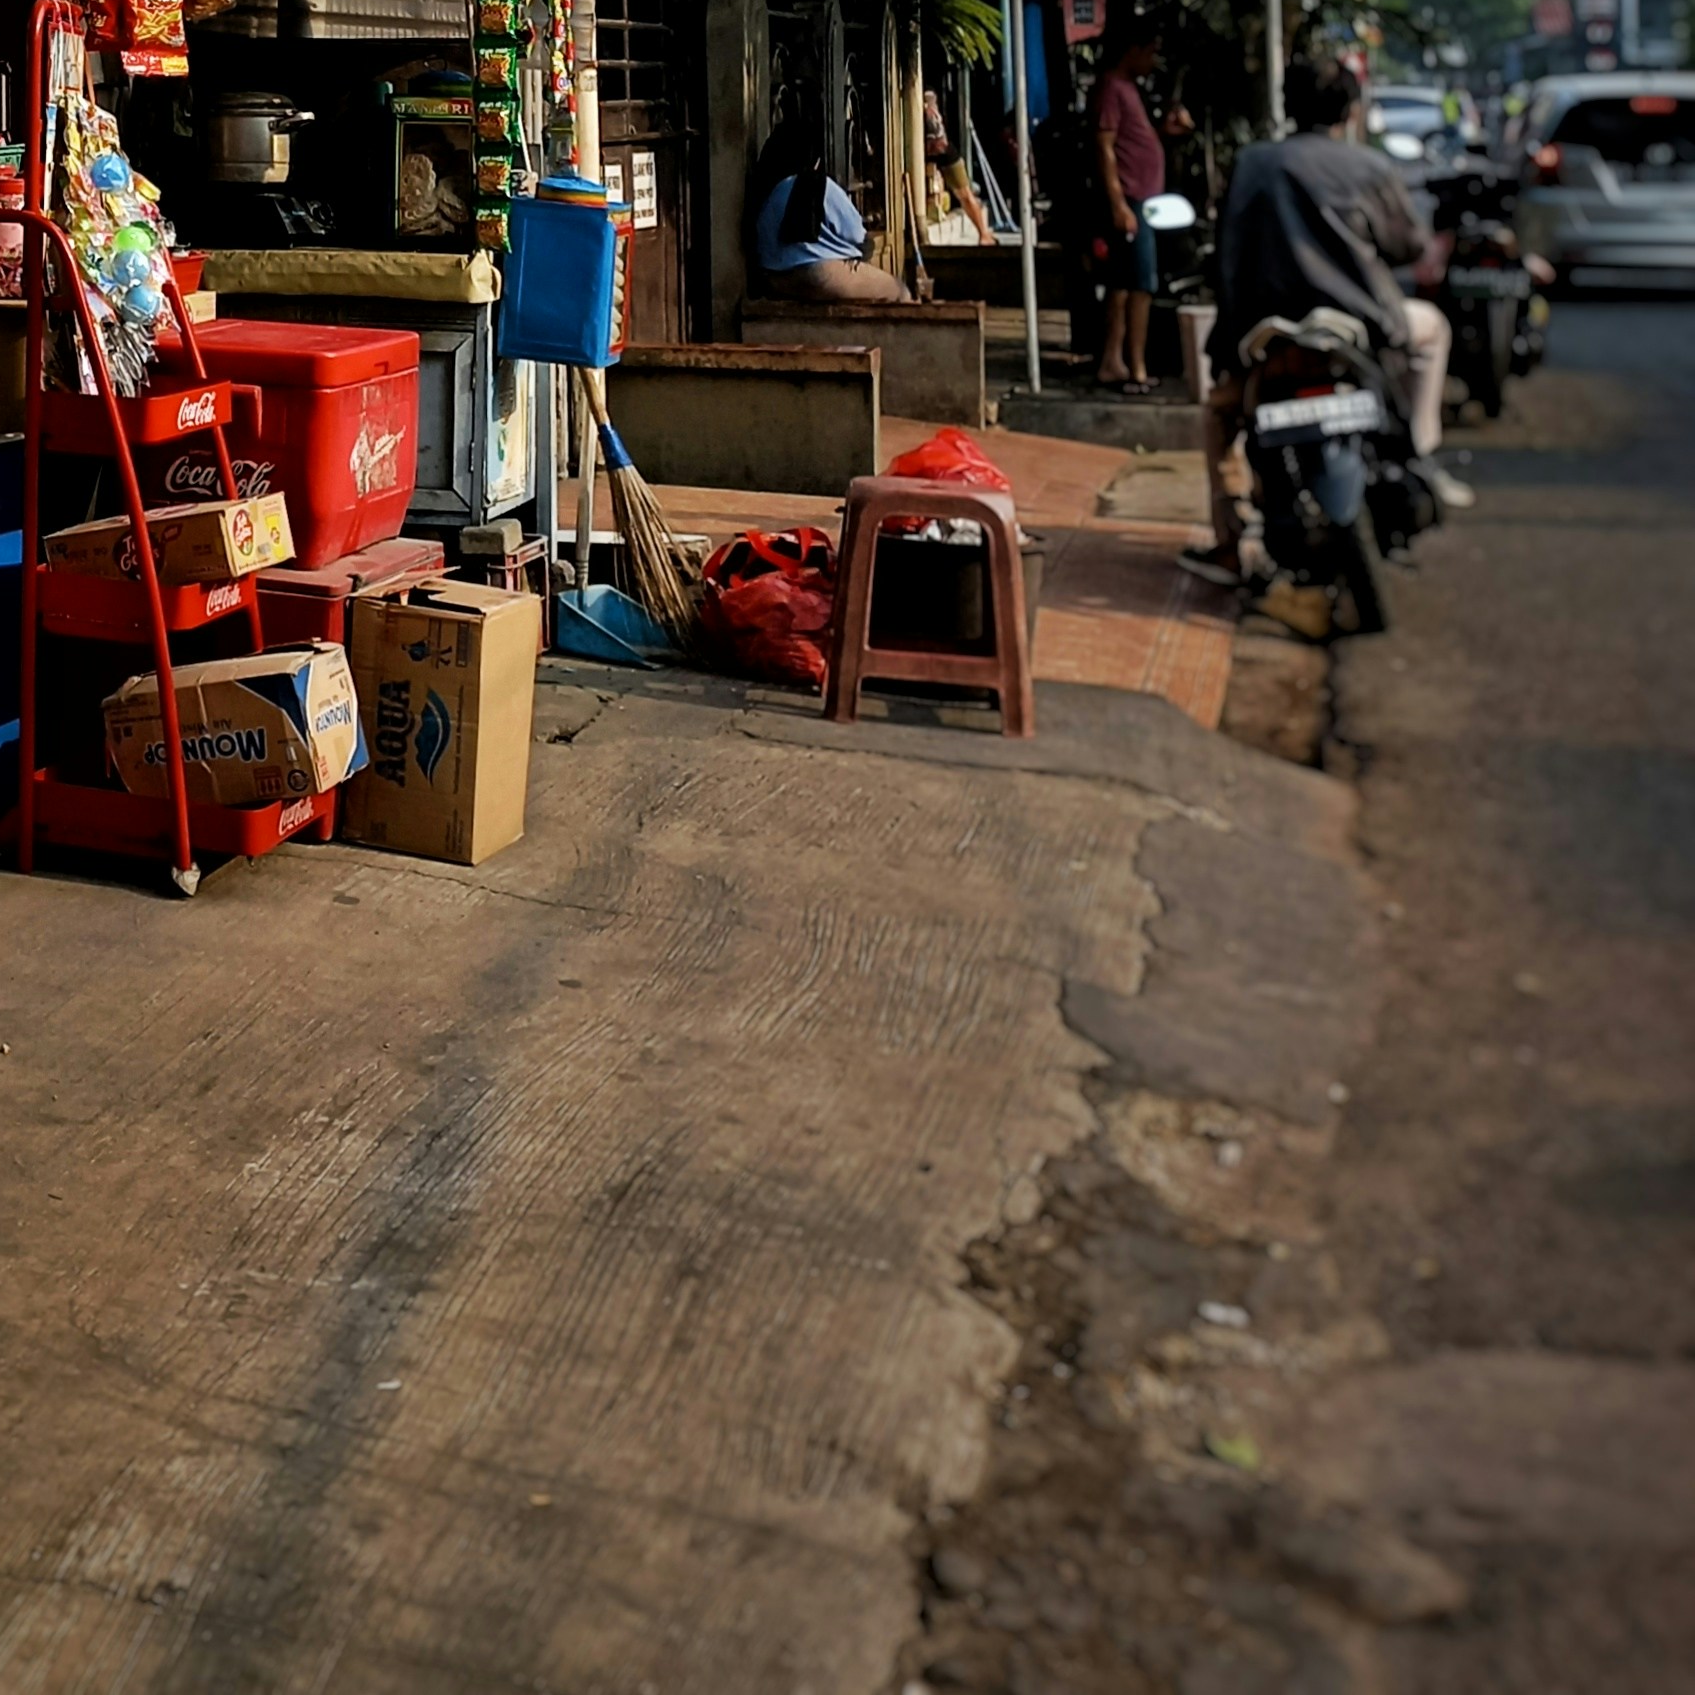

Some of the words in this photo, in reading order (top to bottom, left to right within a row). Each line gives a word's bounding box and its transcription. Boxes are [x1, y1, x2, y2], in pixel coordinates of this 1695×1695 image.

[164, 455, 276, 497] CocaCola
[143, 725, 267, 767] MOUNOP
[374, 678, 415, 788] AQUA
